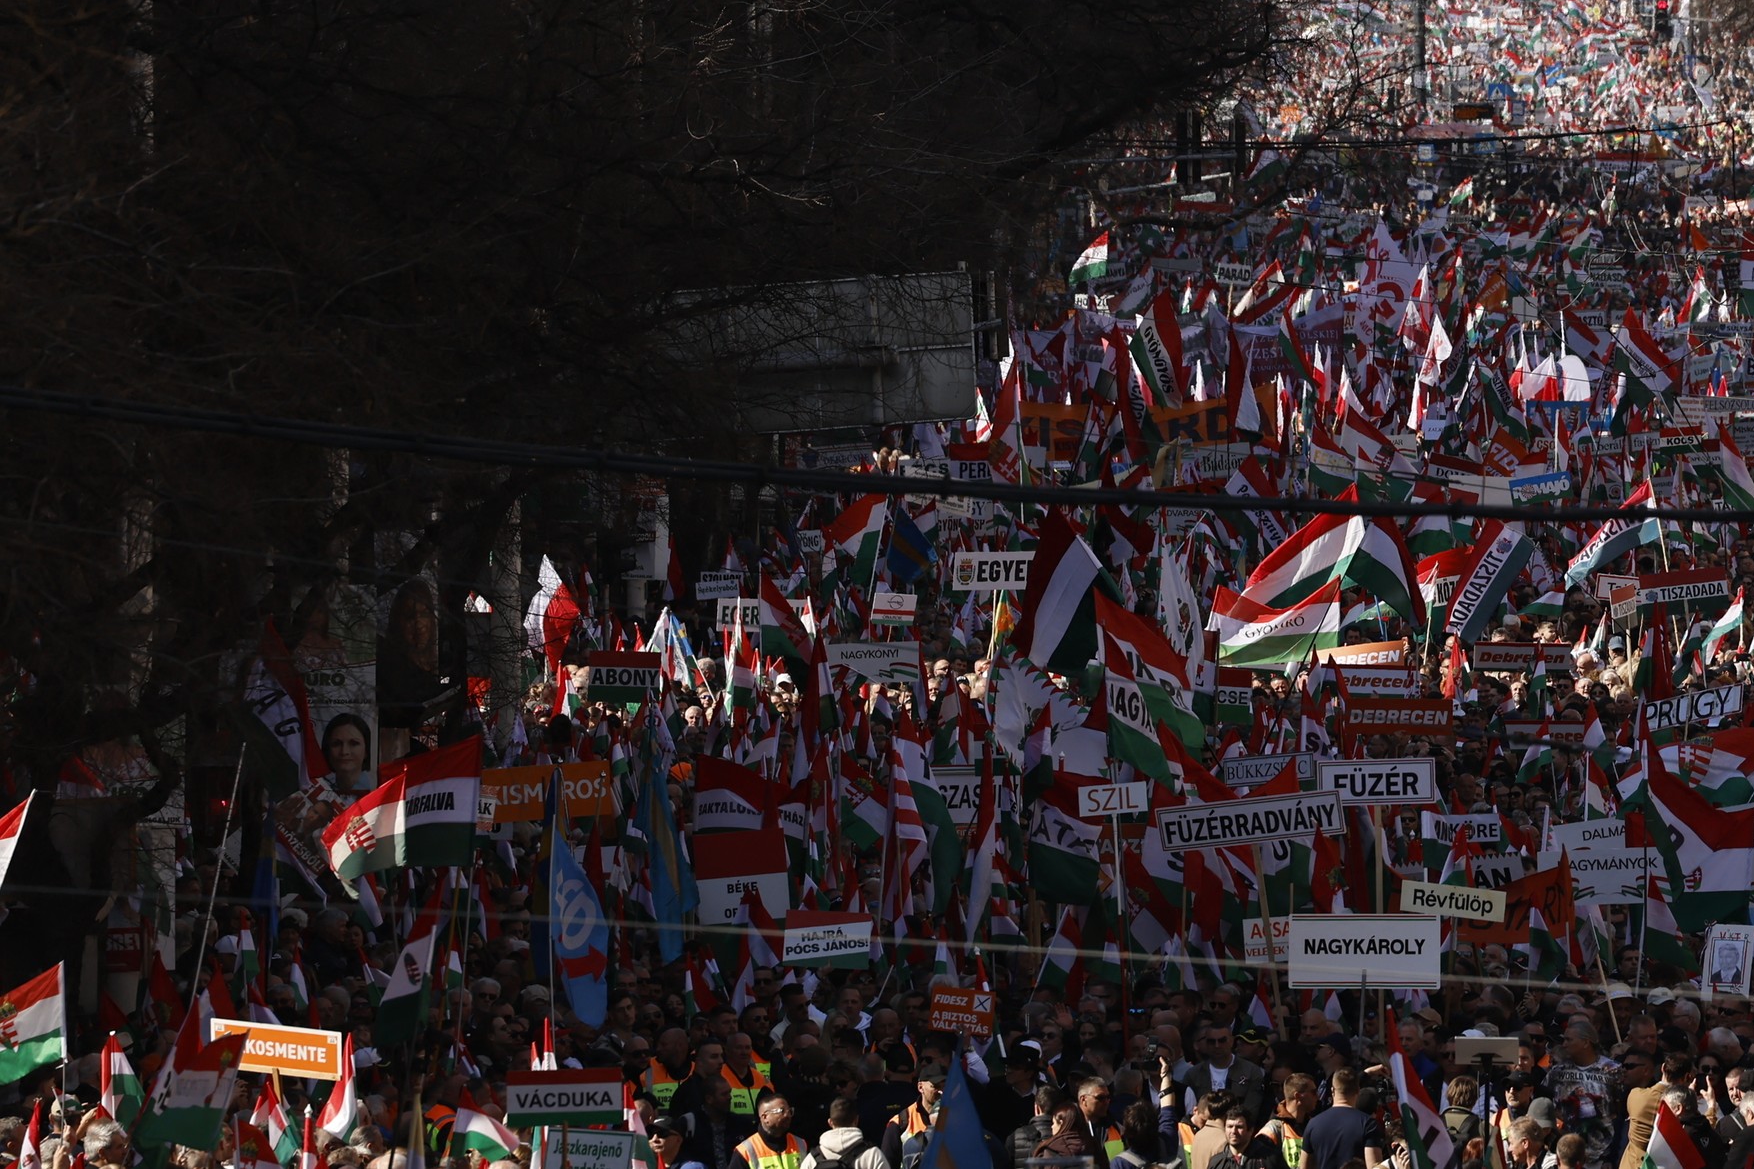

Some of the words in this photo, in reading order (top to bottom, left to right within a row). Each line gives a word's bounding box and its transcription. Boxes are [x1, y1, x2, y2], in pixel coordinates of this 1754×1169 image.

[1144, 325, 1174, 394] GYÖNGYÖS
[976, 559, 1030, 583] EGYE
[1659, 583, 1724, 601] TISZADADA
[841, 649, 899, 660] NAGYKÓNYI
[1480, 651, 1567, 665] Debreen
[591, 668, 660, 686] ABONY
[1349, 709, 1449, 726] DEBRECEN
[1333, 768, 1420, 797] FÜZÉR
[1087, 787, 1139, 813] SZIL
[1163, 800, 1336, 845] FÜZÉRRADVÁNY
[1412, 888, 1494, 917] Révfülöp
[801, 926, 848, 943] HAJRÁ,
[785, 942, 821, 957] PÓCS
[822, 933, 870, 953] JÁNOS!
[1303, 935, 1426, 955] NAGYKÁROLY
[933, 994, 969, 1007] FIDESZ
[932, 1010, 940, 1019] A
[942, 1011, 978, 1024] BIZTOS
[245, 1038, 328, 1064] KOSMENTE
[1559, 1070, 1584, 1082] WORLD
[515, 1089, 614, 1110] VÁCDUKA
